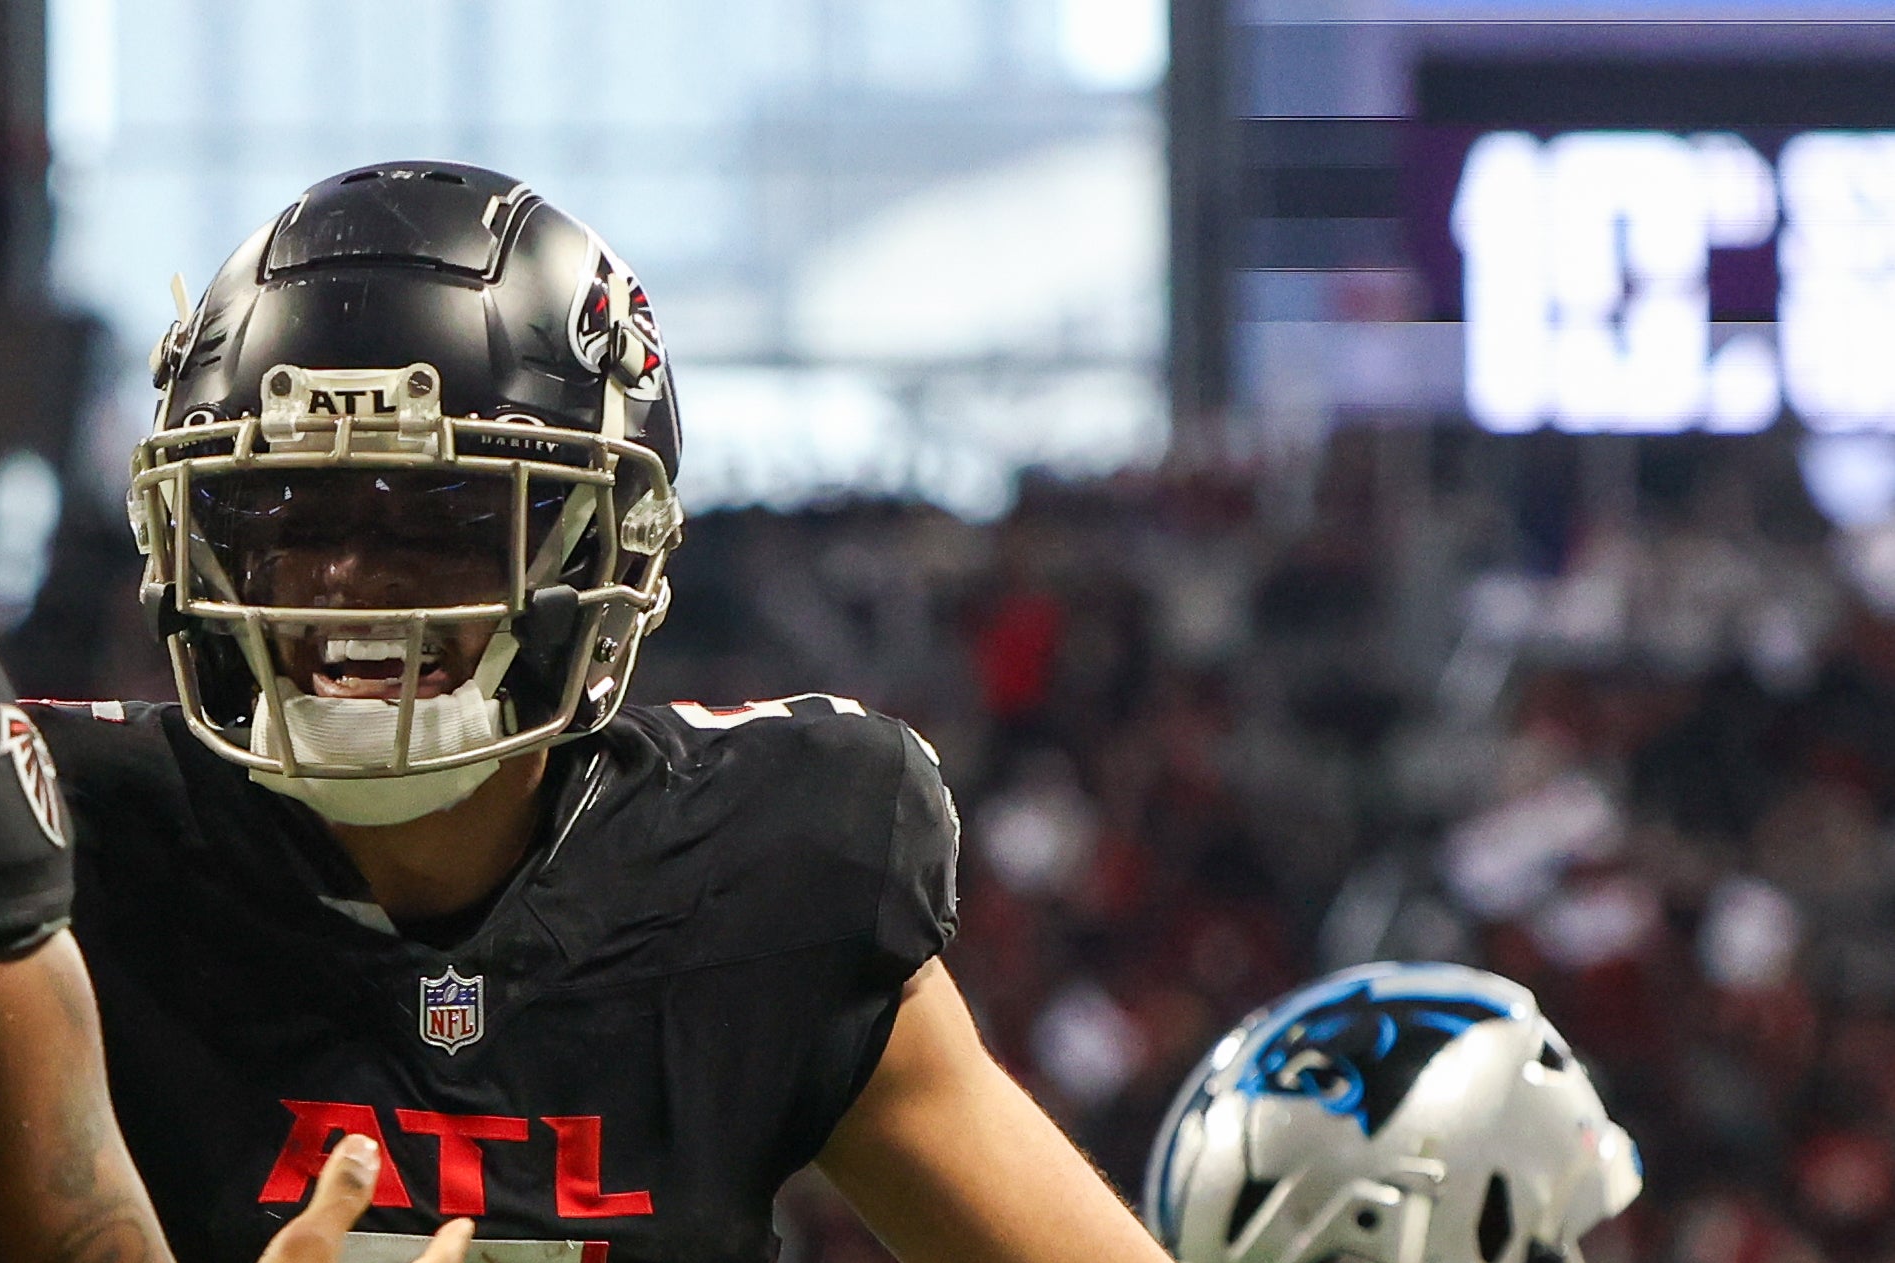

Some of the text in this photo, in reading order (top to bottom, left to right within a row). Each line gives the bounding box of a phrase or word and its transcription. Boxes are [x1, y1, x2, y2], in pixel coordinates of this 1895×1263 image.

[308, 389, 397, 414] ATL
[429, 1008, 474, 1040] NFL
[258, 1099, 654, 1218] ATL
